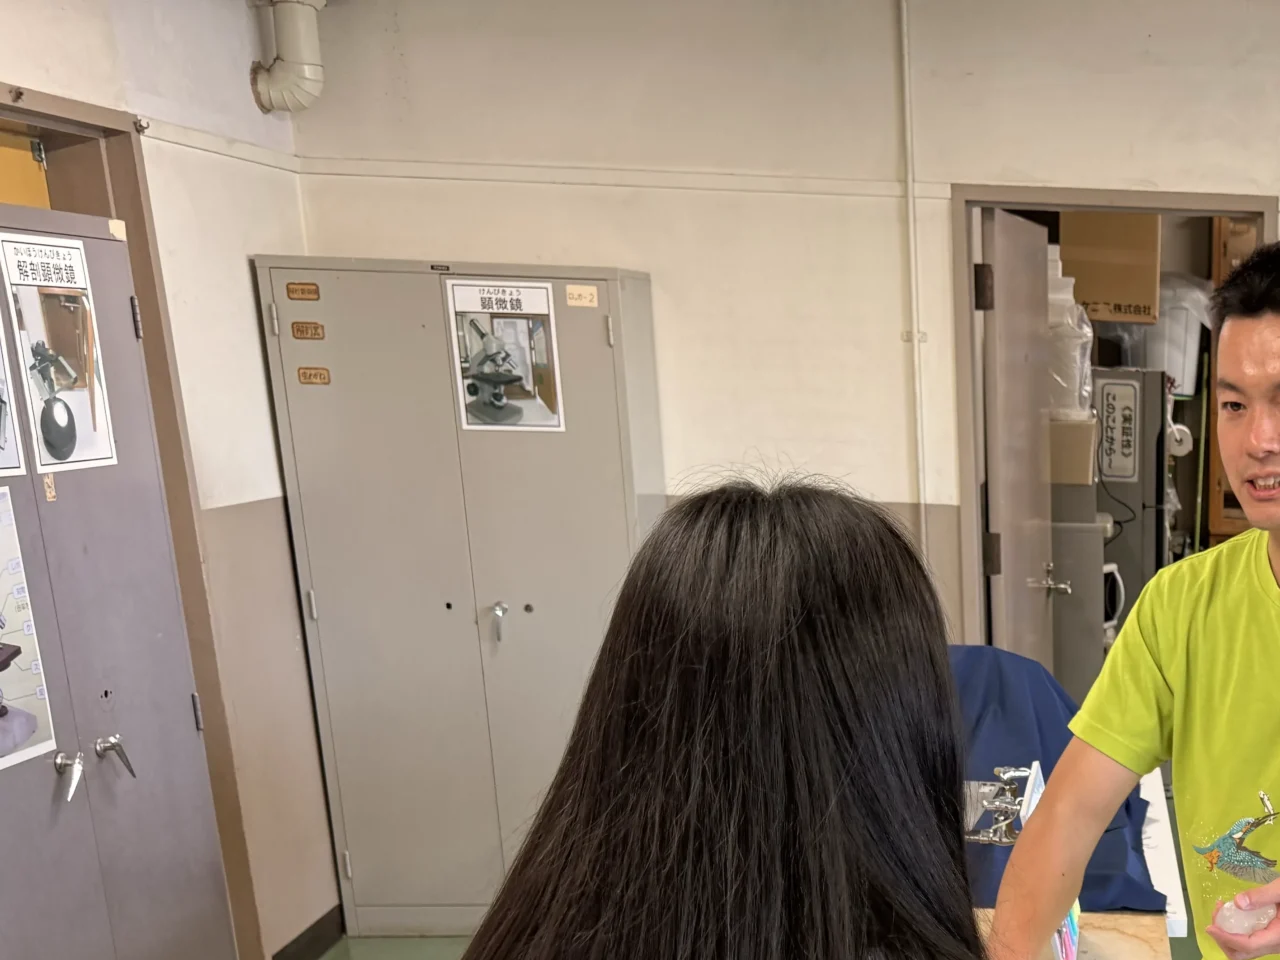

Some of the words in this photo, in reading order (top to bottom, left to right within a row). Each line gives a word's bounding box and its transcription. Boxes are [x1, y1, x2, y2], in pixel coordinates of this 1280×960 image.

[17, 260, 77, 284] 解剖顕微鏡
[478, 288, 522, 296] けんびきょう
[480, 297, 523, 312] 顕微鏡
